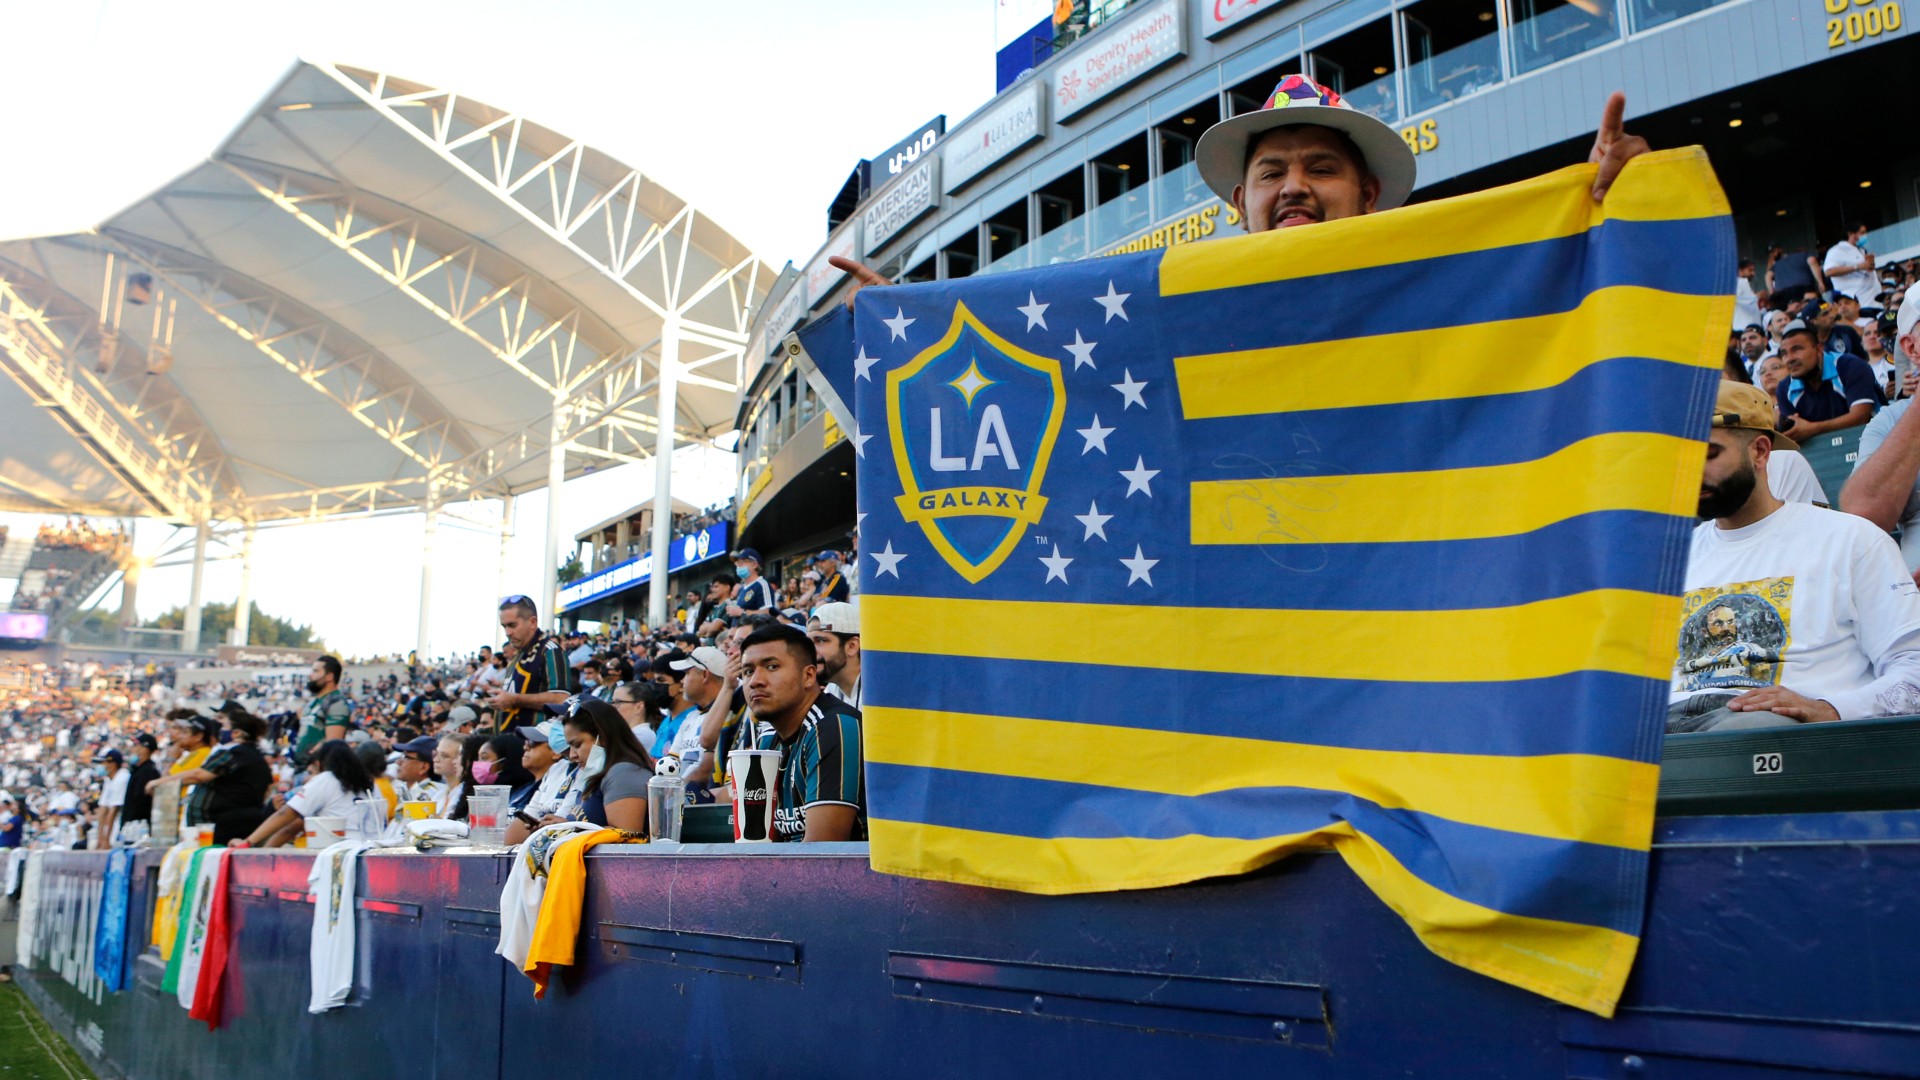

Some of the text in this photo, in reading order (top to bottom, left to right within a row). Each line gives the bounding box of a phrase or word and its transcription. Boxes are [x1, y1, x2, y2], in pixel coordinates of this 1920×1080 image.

[1086, 13, 1171, 73] Dignity Health
[1826, 2, 1901, 49] 2000
[1086, 45, 1152, 93] Sports Park
[991, 106, 1033, 143] ULTRA
[867, 164, 929, 230] AMERICAN
[874, 184, 929, 243] EXPRESS
[930, 404, 1020, 472] LA
[918, 491, 1029, 511] GALAXY
[1755, 755, 1781, 772] 20
